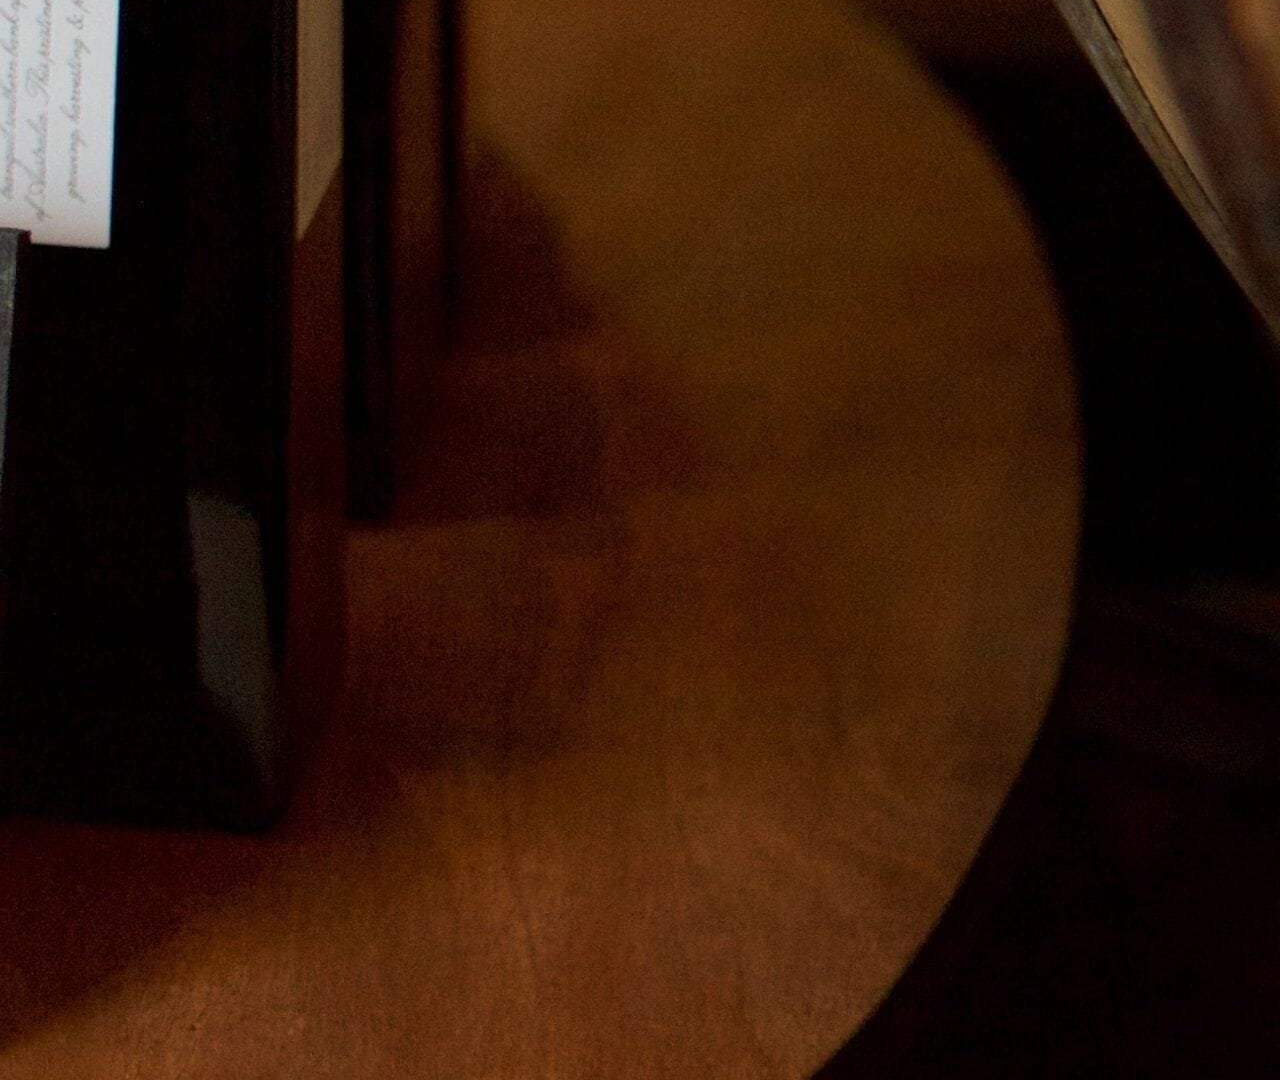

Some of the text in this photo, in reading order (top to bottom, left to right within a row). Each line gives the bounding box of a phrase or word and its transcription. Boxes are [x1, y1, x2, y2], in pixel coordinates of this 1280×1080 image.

[66, 13, 85, 31] &
[25, 62, 49, 108] This
[59, 38, 91, 124] harvesting
